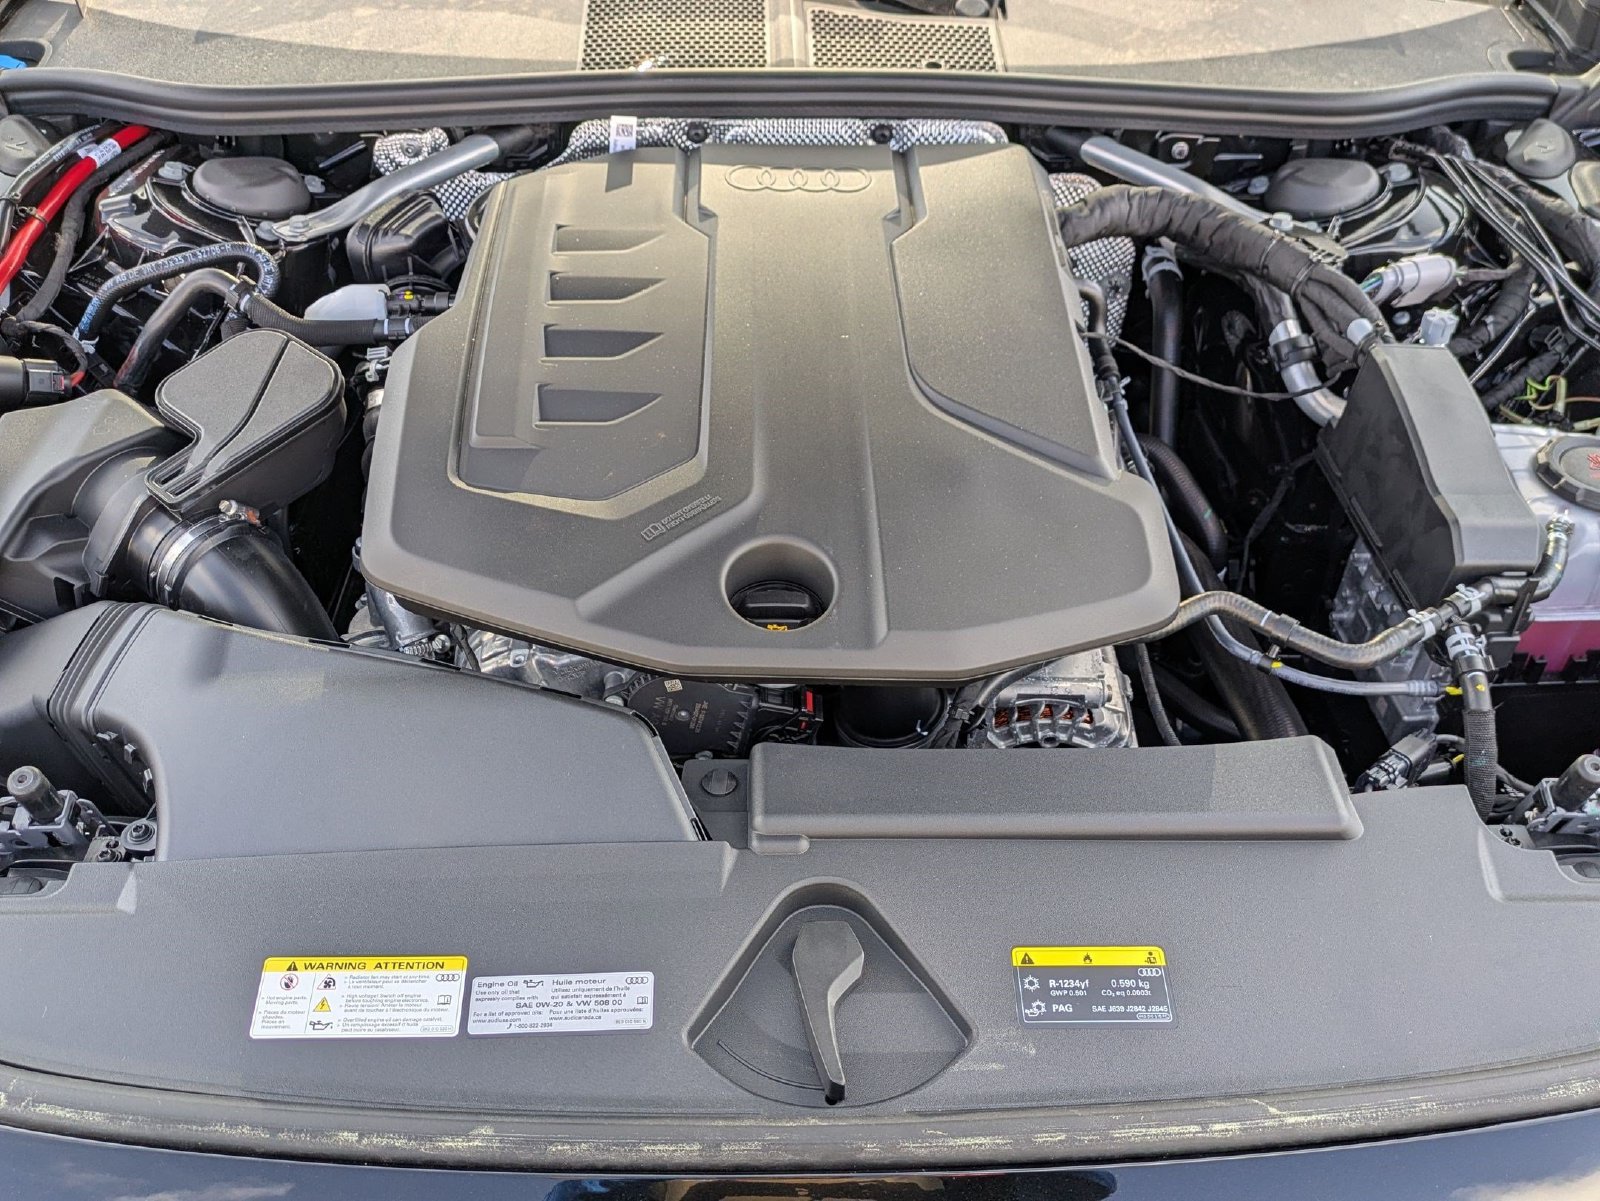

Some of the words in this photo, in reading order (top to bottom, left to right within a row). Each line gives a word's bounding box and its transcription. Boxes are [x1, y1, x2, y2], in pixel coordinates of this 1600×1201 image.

[128, 270, 139, 279] DE
[670, 510, 684, 519] NOT
[304, 962, 366, 970] WARNING
[373, 961, 445, 970] ATTENTION
[1049, 979, 1089, 989] R-1234yf
[1111, 979, 1136, 988] 0.590
[1138, 979, 1150, 989] kg
[1052, 1004, 1073, 1012] PAG
